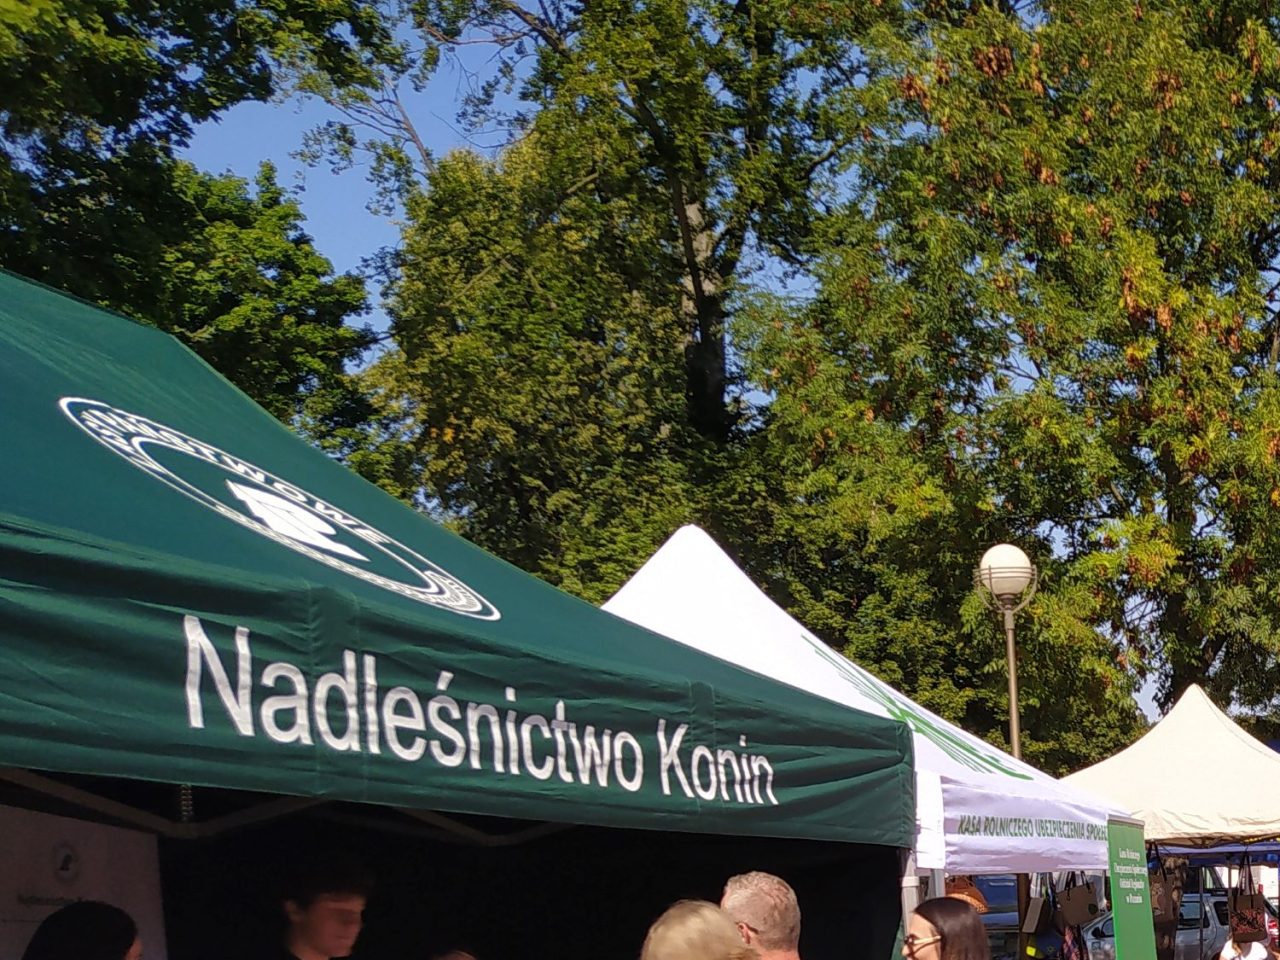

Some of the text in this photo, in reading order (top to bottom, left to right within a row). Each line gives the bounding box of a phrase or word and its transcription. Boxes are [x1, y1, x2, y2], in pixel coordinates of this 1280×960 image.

[183, 614, 779, 806] Nadleśnictwo Konin
[958, 815, 980, 837] KASA
[983, 815, 1034, 839] ROLNICZEGO
[1035, 818, 1085, 840] UBEZPIECZENIA
